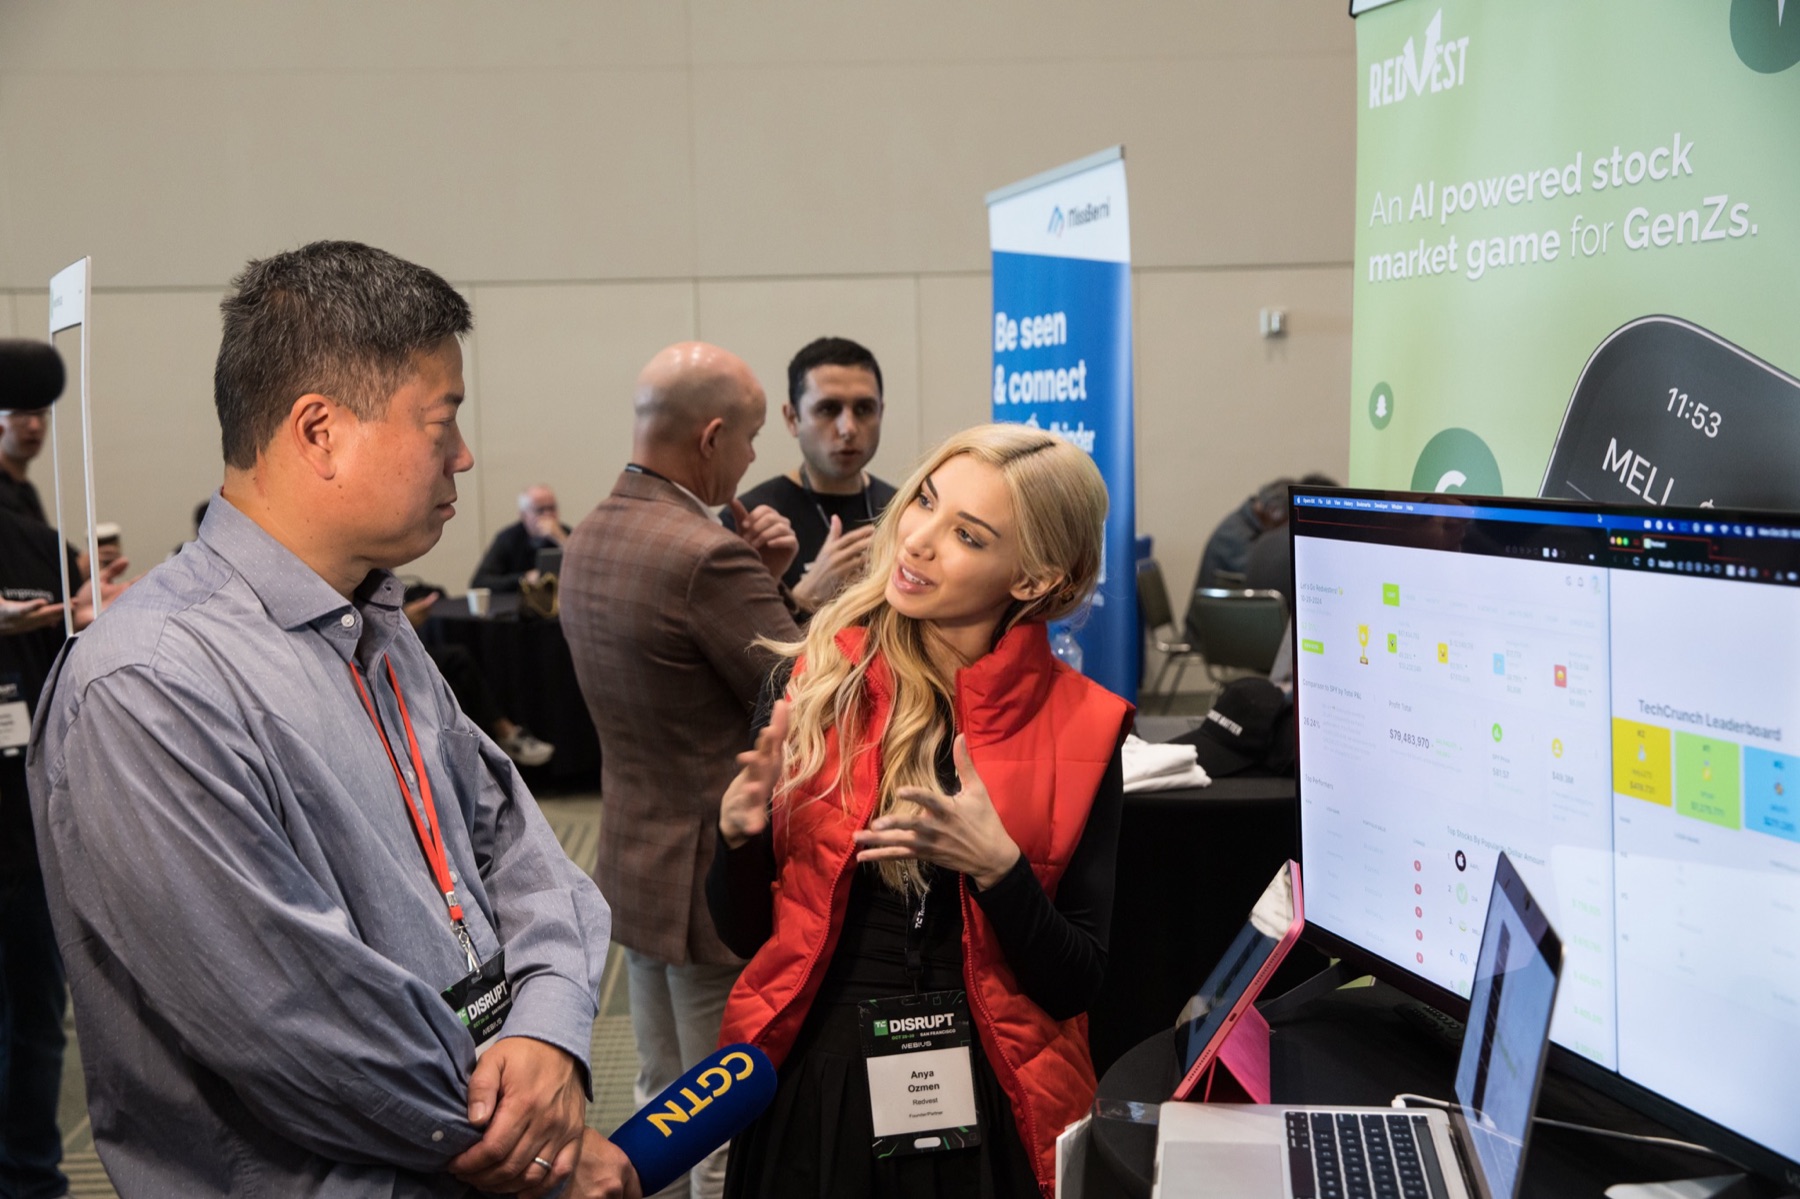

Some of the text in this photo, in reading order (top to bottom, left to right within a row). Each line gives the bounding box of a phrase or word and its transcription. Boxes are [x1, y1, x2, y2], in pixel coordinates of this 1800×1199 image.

[1368, 8, 1469, 108] REDVEST
[1369, 132, 1694, 228] An AI powered stock
[1368, 195, 1758, 282] market game for GenZs.
[994, 310, 1067, 352] Be seen
[993, 359, 1087, 405] & connect
[1664, 387, 1723, 438] 11:53
[1601, 437, 1675, 507] MELI
[1638, 699, 1783, 742] TechCrunch Leaderboard
[467, 980, 508, 1020] DISRUPT
[889, 1013, 954, 1033] DISRUPT
[930, 1028, 956, 1036] FRANCISCO
[901, 1040, 932, 1050] NEBIUS
[646, 1051, 755, 1138] CGTN
[907, 1082, 940, 1093] Ozmen
[910, 1070, 935, 1080] Anya
[912, 1097, 938, 1106] Redvest
